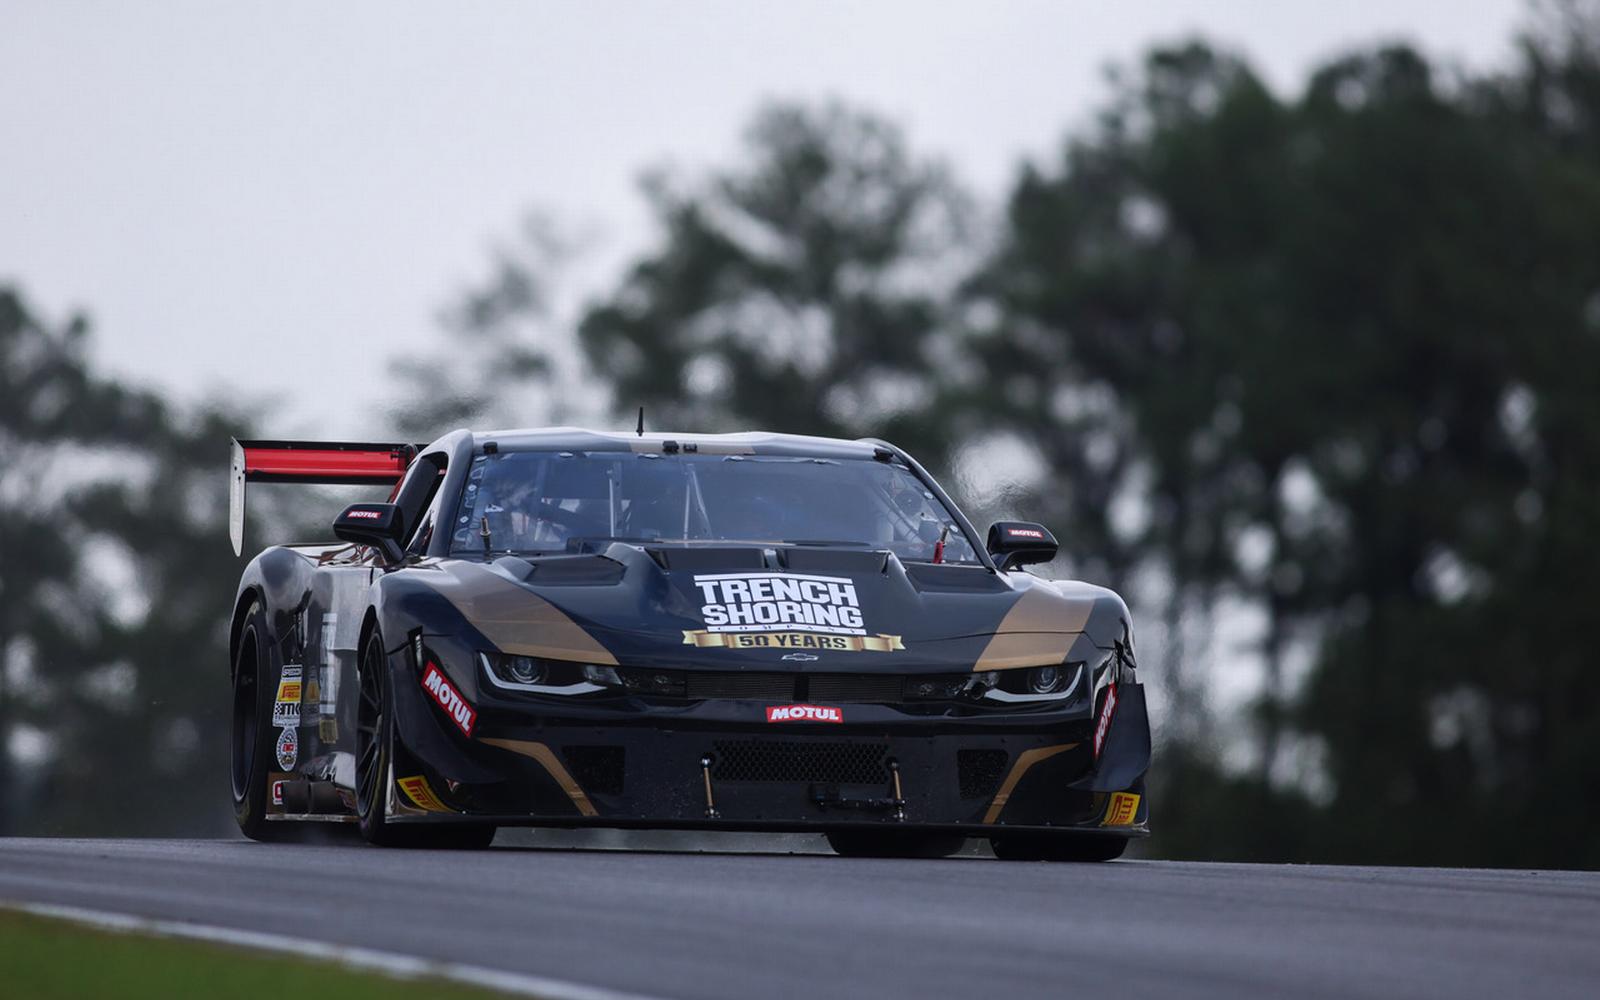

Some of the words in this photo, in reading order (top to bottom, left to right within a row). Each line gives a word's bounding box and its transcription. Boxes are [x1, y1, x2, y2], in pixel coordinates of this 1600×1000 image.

[696, 578, 859, 607] TRENCH
[701, 601, 864, 628] SHORING
[739, 635, 769, 646] 50
[775, 634, 847, 649] YEARS
[424, 669, 472, 733] MOTUL
[770, 706, 839, 721] MOTUL
[1095, 687, 1115, 755] MOTUL
